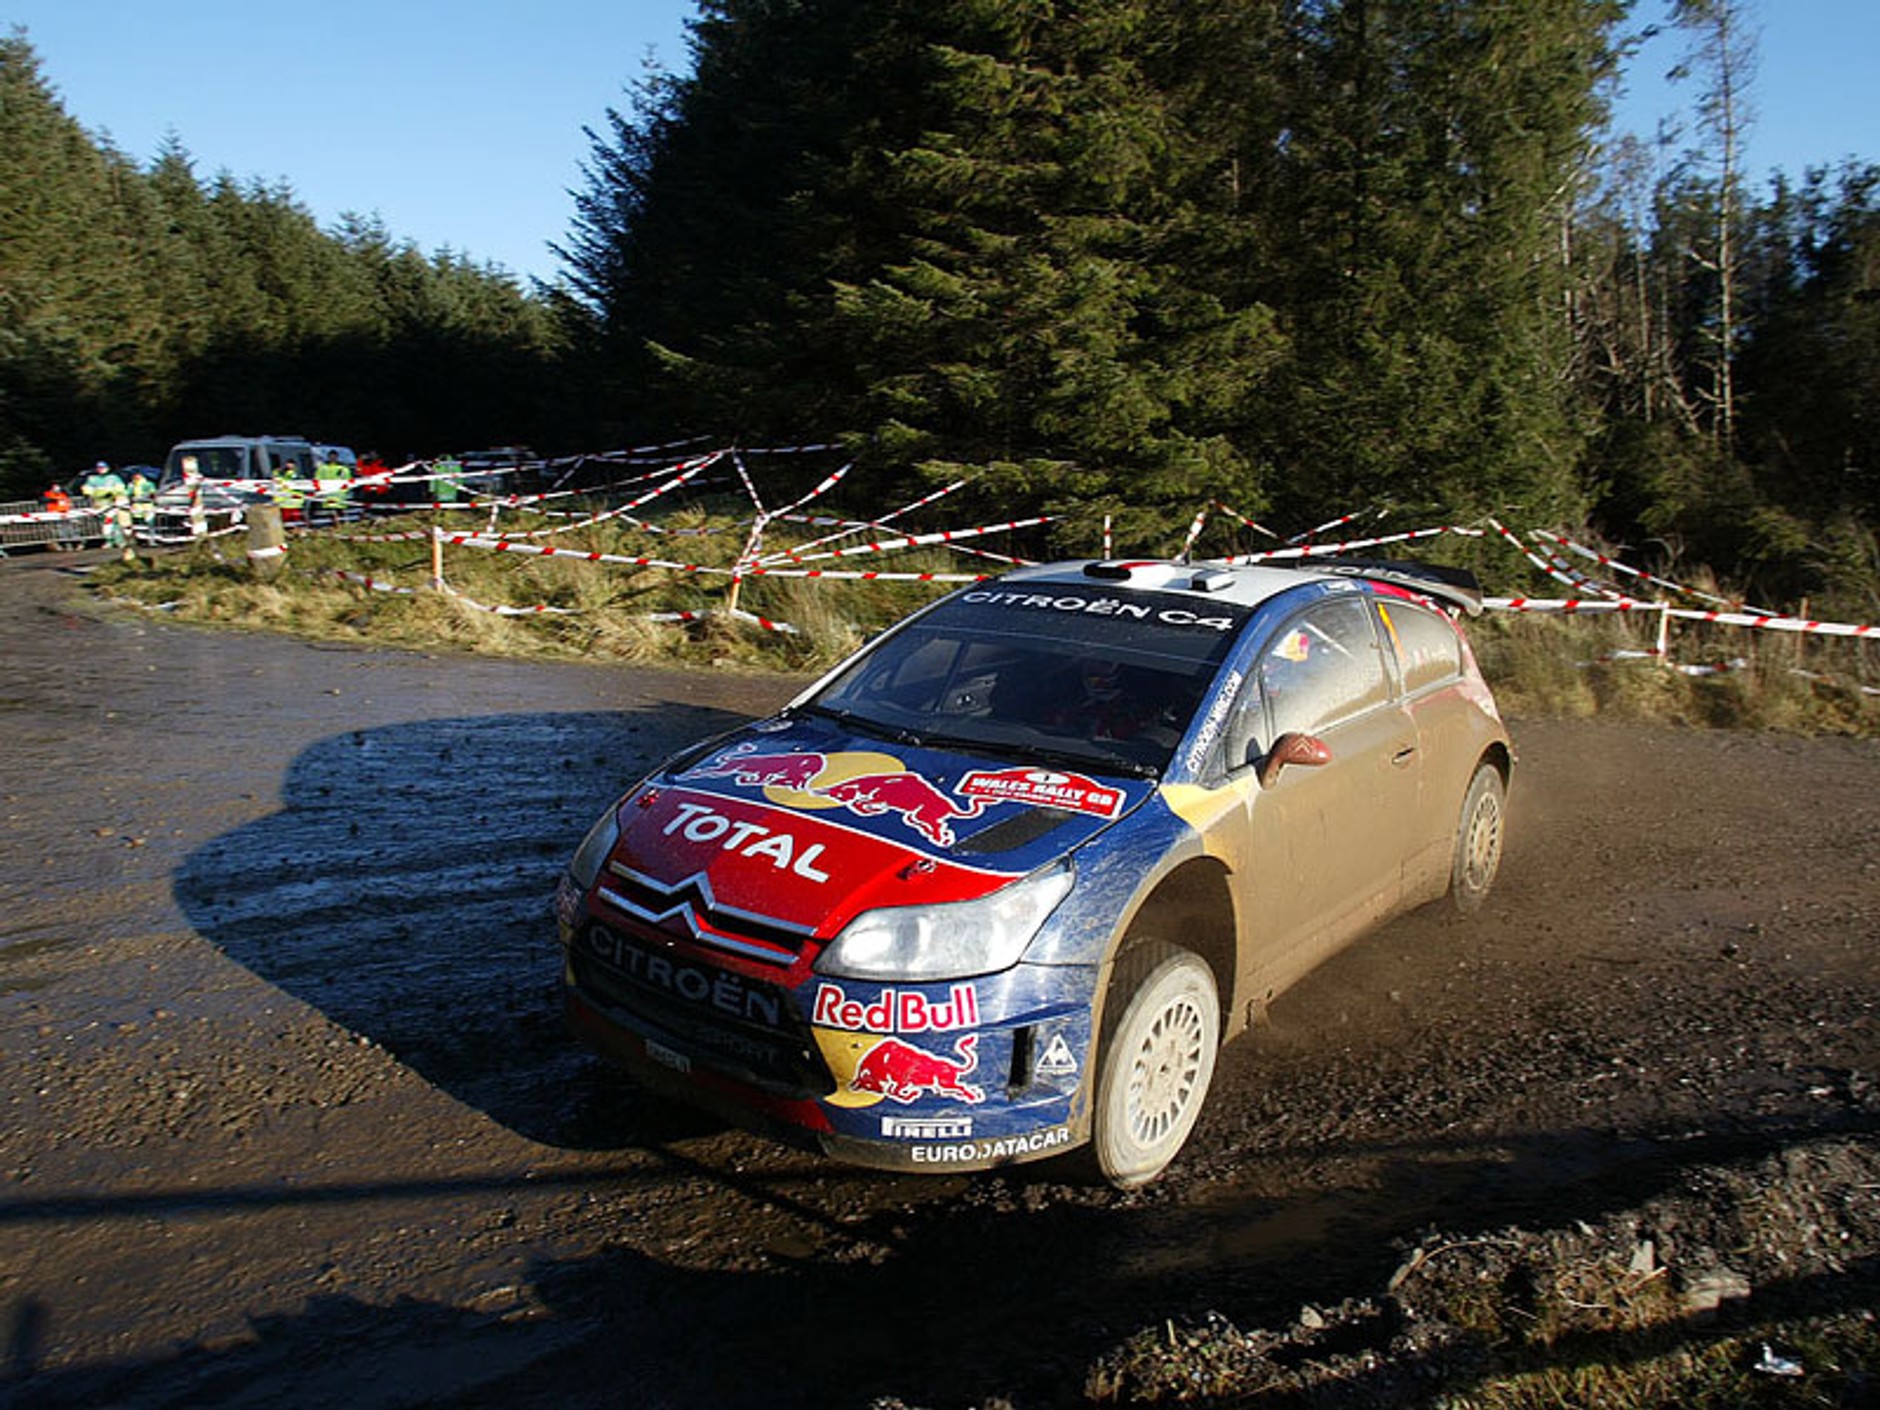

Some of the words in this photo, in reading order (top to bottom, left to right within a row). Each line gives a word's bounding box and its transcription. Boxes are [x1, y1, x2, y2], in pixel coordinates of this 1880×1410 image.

[963, 591, 1151, 618] CITROËN
[1158, 609, 1234, 631] C4
[970, 777, 1031, 791] WALES
[1032, 783, 1086, 801] RALLY
[1086, 791, 1114, 805] GB
[661, 803, 830, 883] TOTAL
[589, 925, 780, 1026] CITROËN
[813, 984, 893, 1031] Red
[898, 984, 979, 1031] Bull
[881, 1116, 972, 1138] PIRELLI
